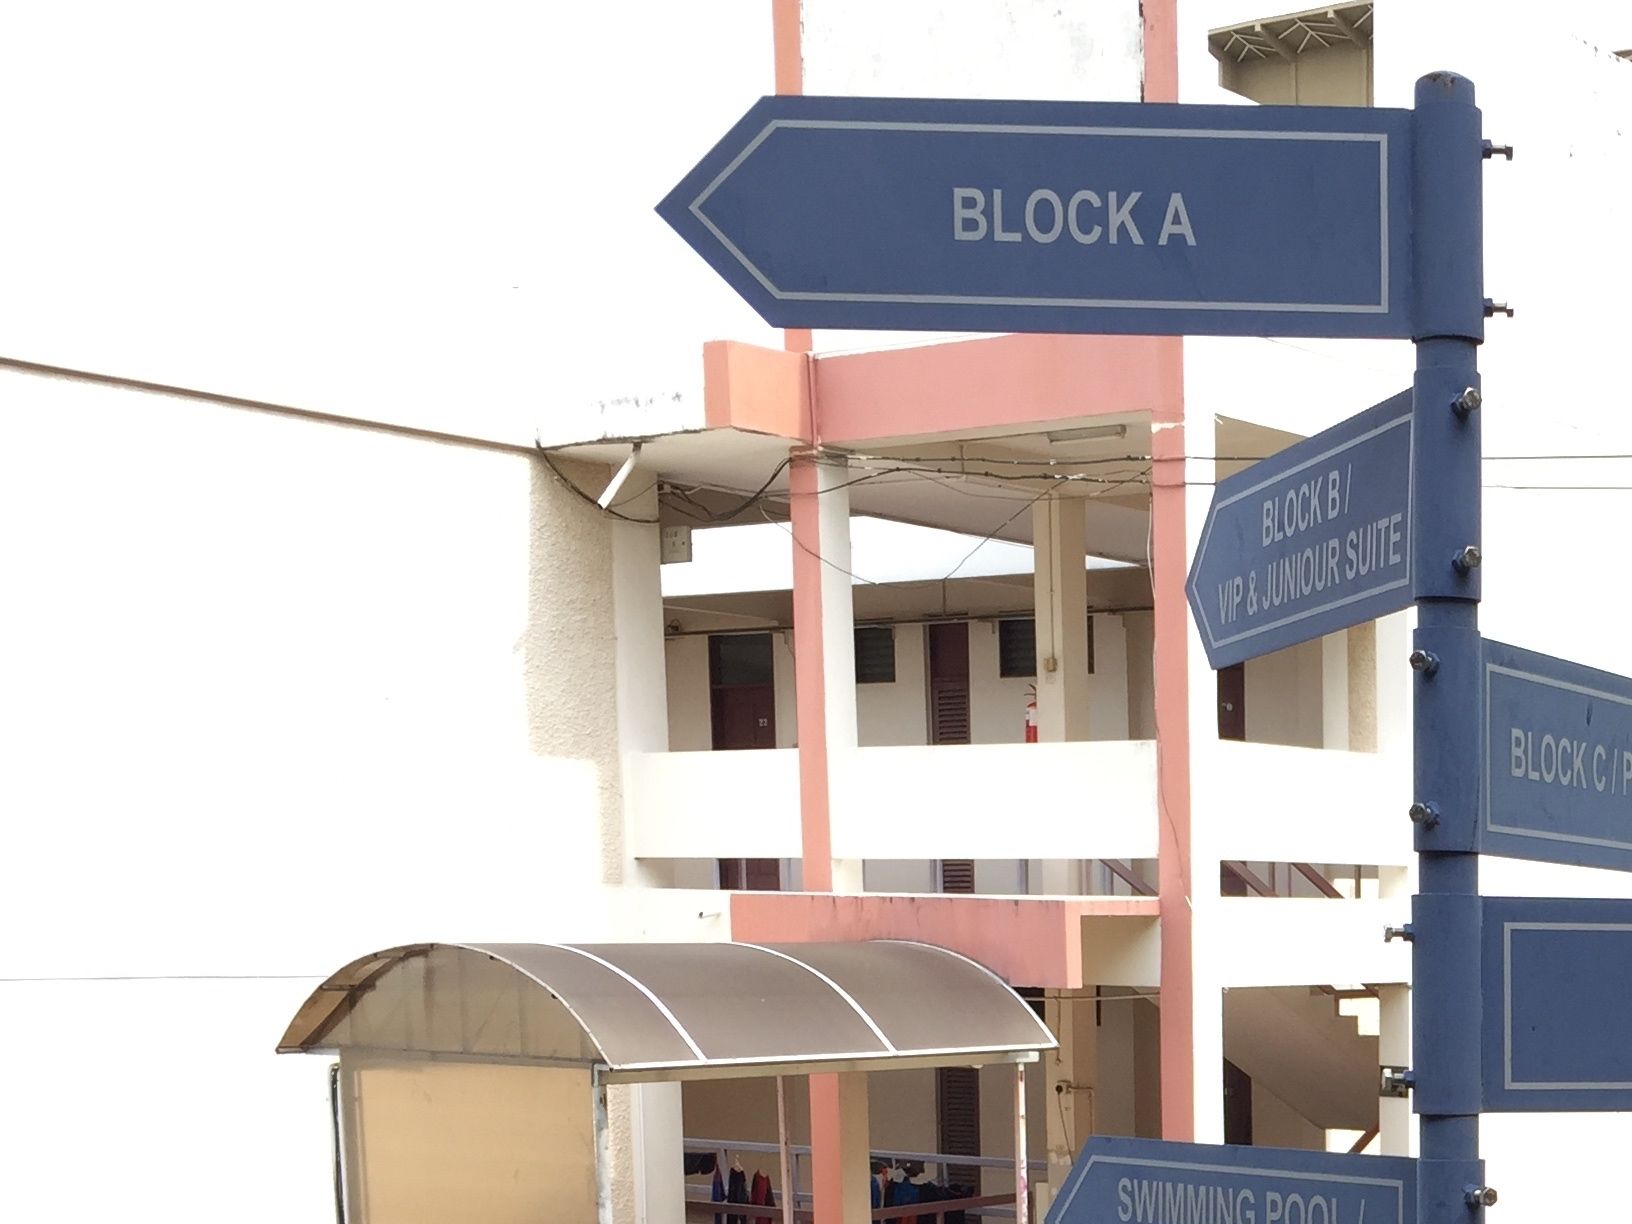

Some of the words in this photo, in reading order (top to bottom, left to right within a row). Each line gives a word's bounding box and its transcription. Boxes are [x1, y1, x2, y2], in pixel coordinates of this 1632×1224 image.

[953, 186, 1144, 246] BLOCK
[1157, 192, 1197, 247] A
[1262, 475, 1323, 548] BLOCK
[1327, 469, 1341, 520] B
[1218, 575, 1243, 625] VIP
[1246, 570, 1258, 616] &
[1262, 537, 1340, 610] JUNIOUR
[1345, 512, 1402, 581] SUITE
[1510, 727, 1587, 790] BLOCK
[1592, 744, 1606, 793] C
